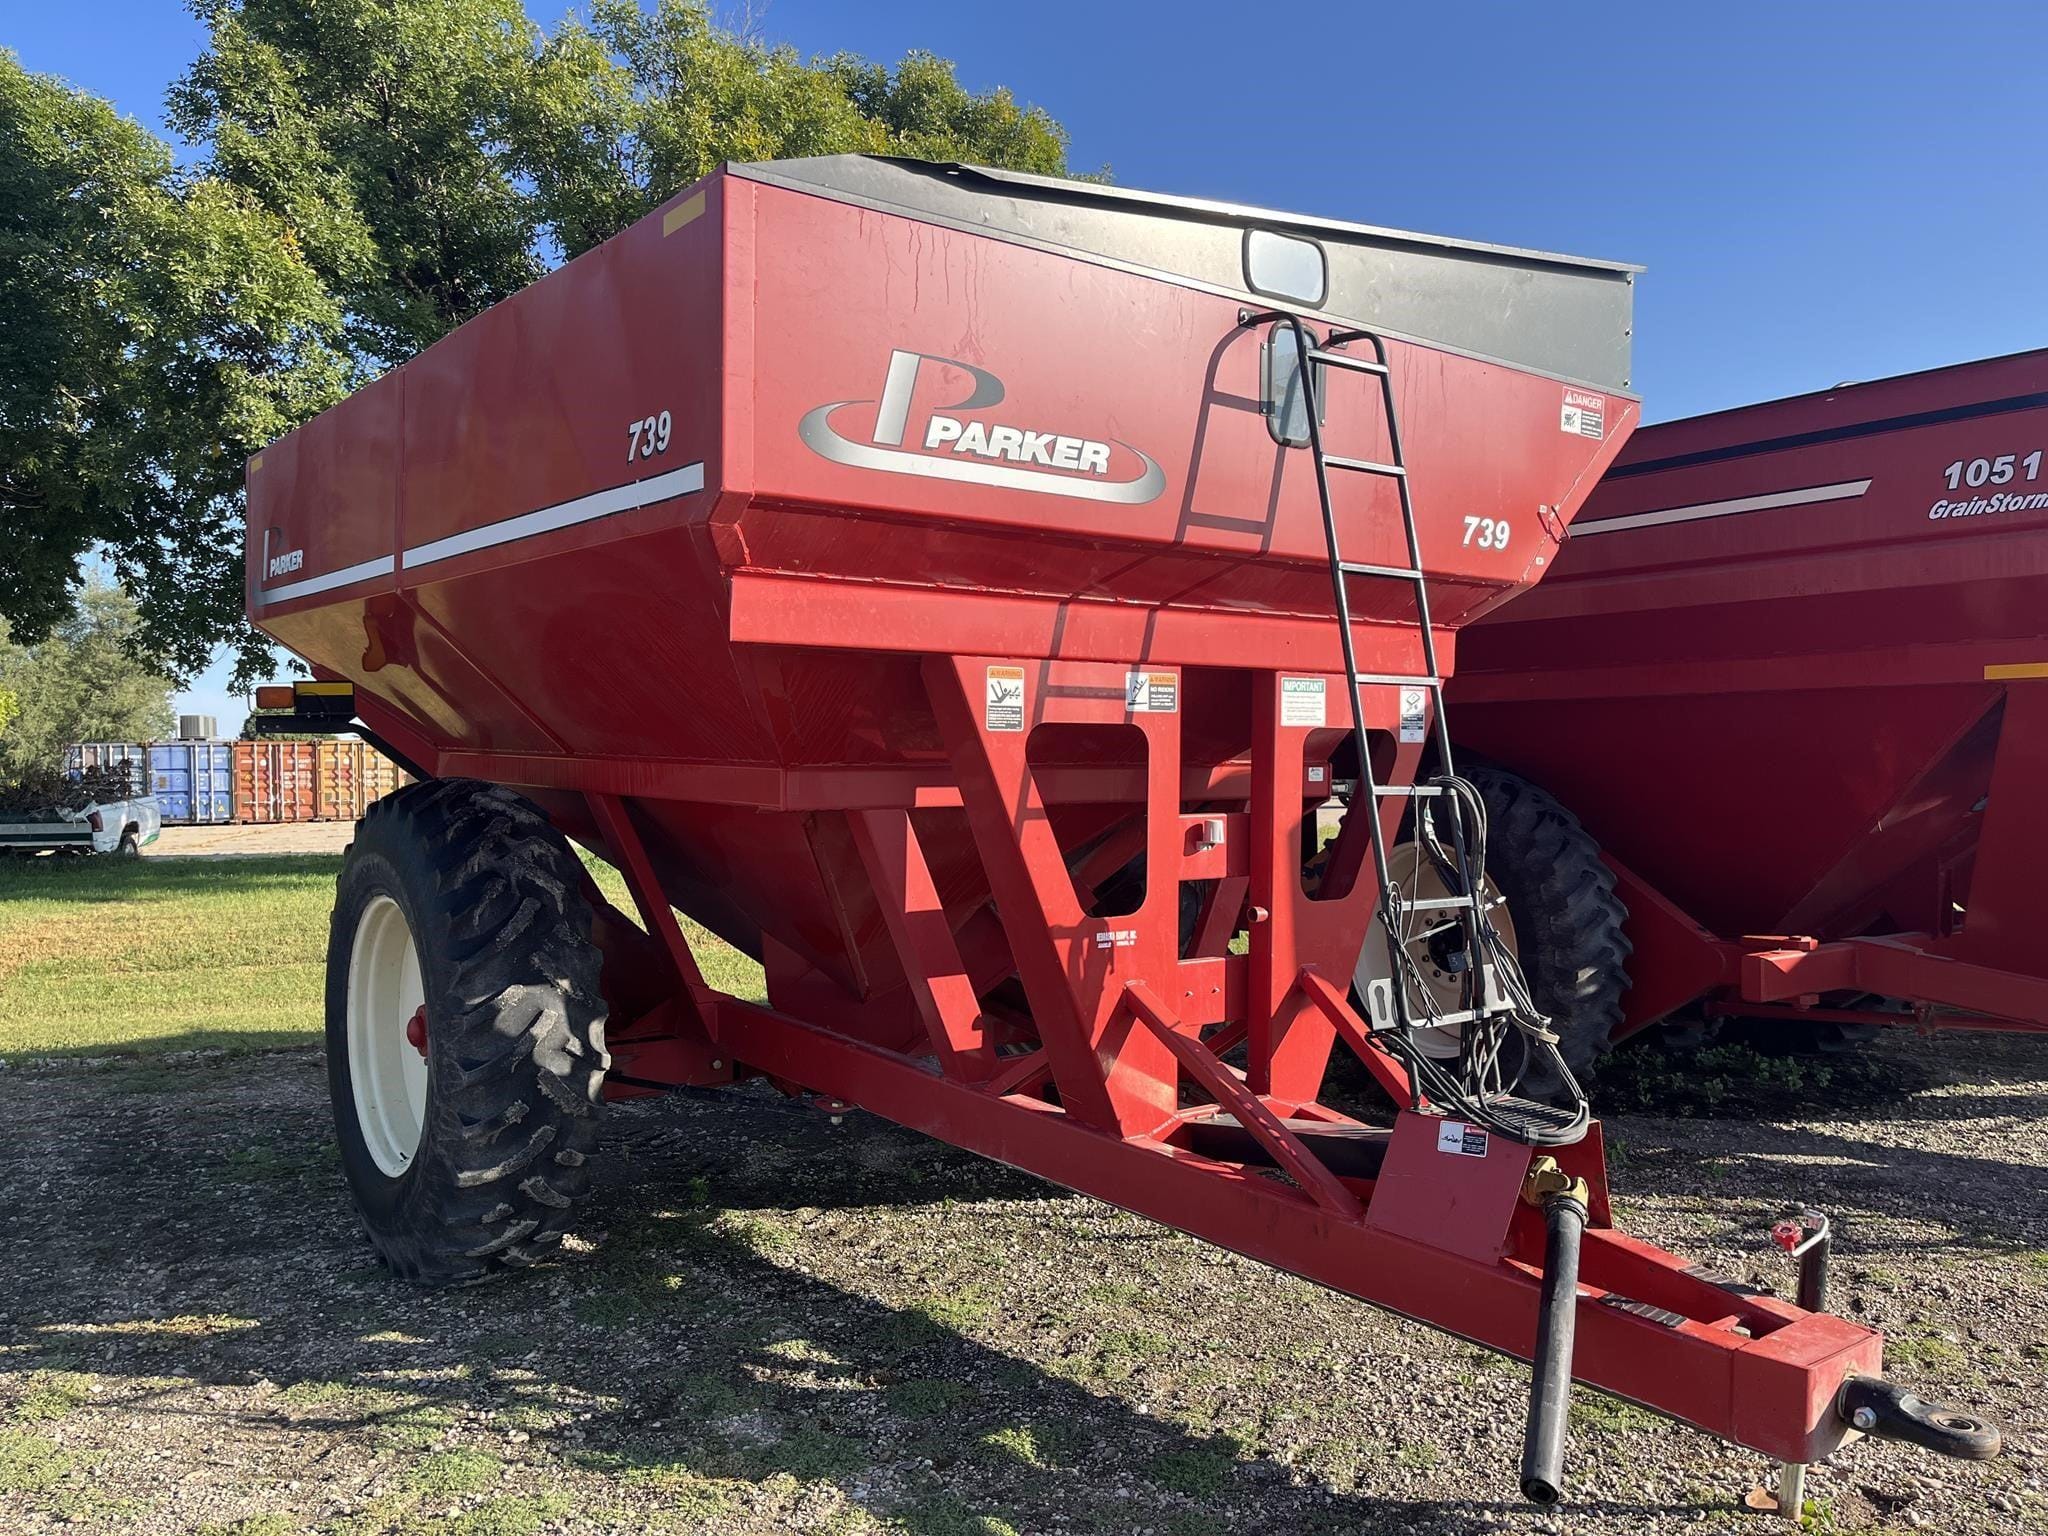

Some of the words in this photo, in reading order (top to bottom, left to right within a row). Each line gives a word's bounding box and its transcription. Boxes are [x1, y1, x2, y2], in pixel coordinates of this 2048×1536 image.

[1573, 393, 1602, 410] DANGER
[627, 410, 672, 464] 739
[923, 414, 1111, 475] PARKER
[1944, 450, 2042, 490] 1051
[1928, 492, 2048, 520] GrainStorm
[1462, 515, 1511, 551] 739
[269, 549, 304, 578] PARKER
[1283, 680, 1323, 692] IMPORTANT
